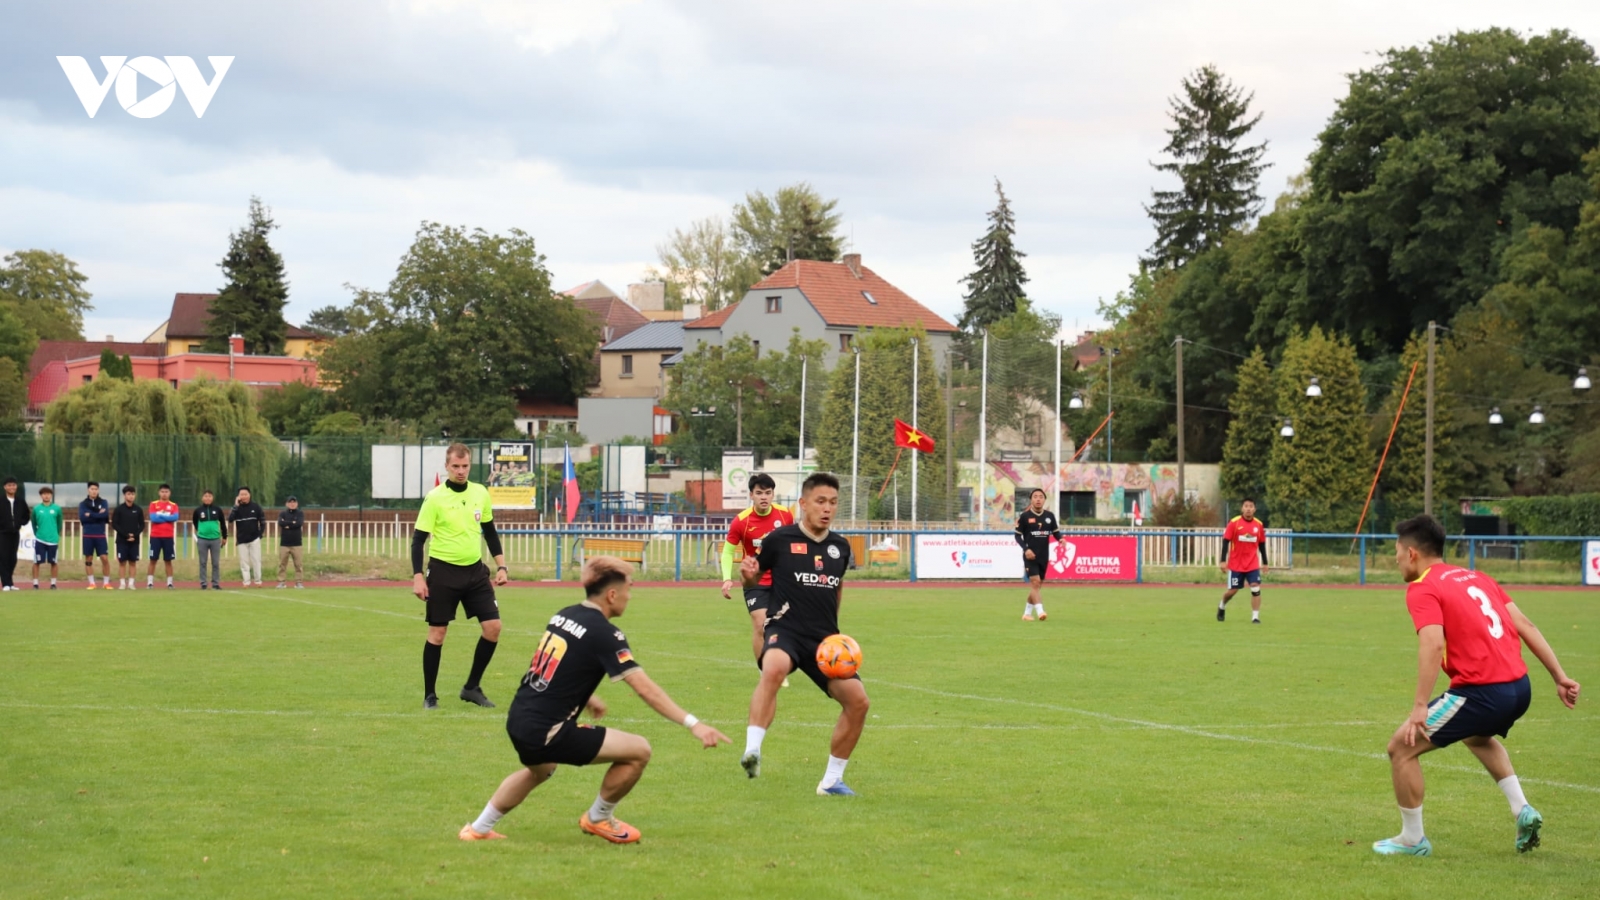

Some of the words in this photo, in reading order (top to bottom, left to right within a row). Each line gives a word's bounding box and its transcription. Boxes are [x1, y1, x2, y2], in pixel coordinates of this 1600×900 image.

[1075, 557, 1120, 566] ATLETIKA
[1231, 577, 1239, 586] 12
[1466, 585, 1504, 640] 3
[561, 618, 588, 640] TEAM
